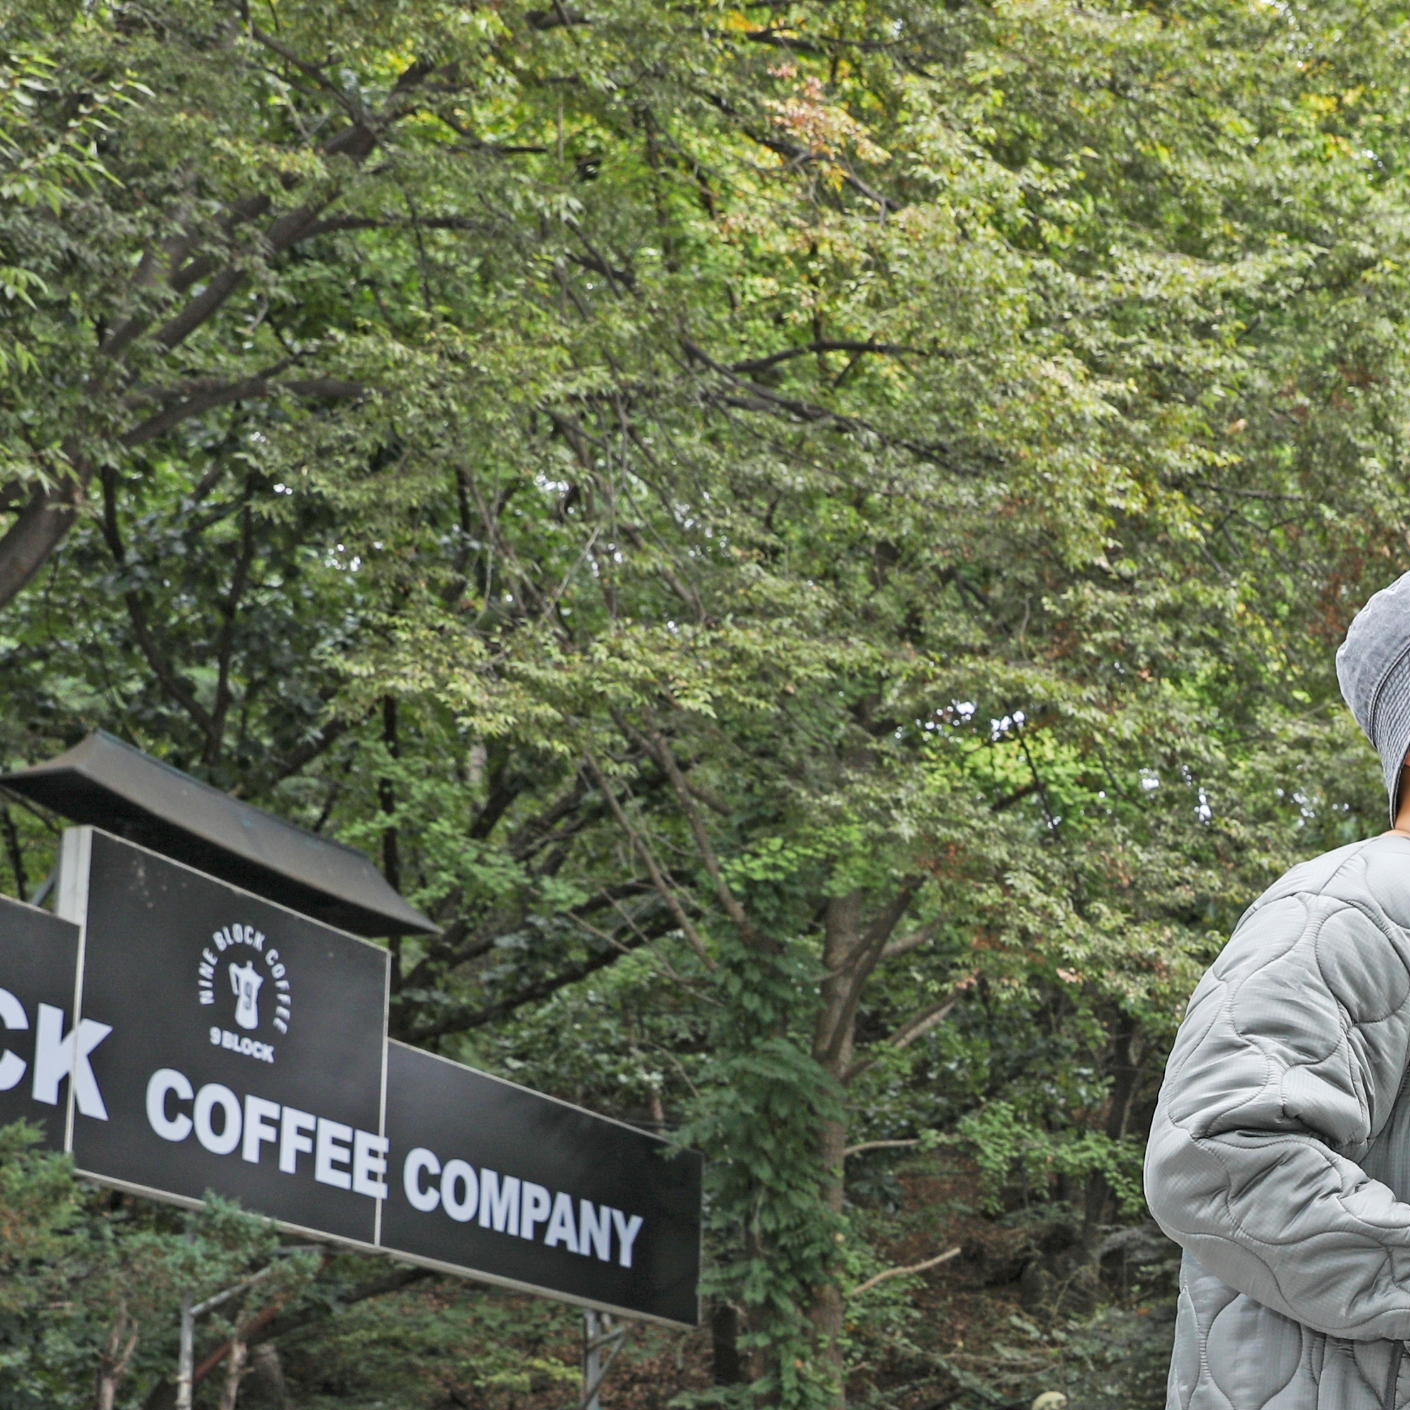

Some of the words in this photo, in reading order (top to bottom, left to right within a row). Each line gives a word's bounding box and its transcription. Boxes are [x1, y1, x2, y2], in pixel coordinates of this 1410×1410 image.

[198, 947, 219, 1005] NINE
[212, 923, 266, 952] BLOCK
[145, 1068, 389, 1200] COFFEE
[403, 1147, 643, 1269] COMPANY
